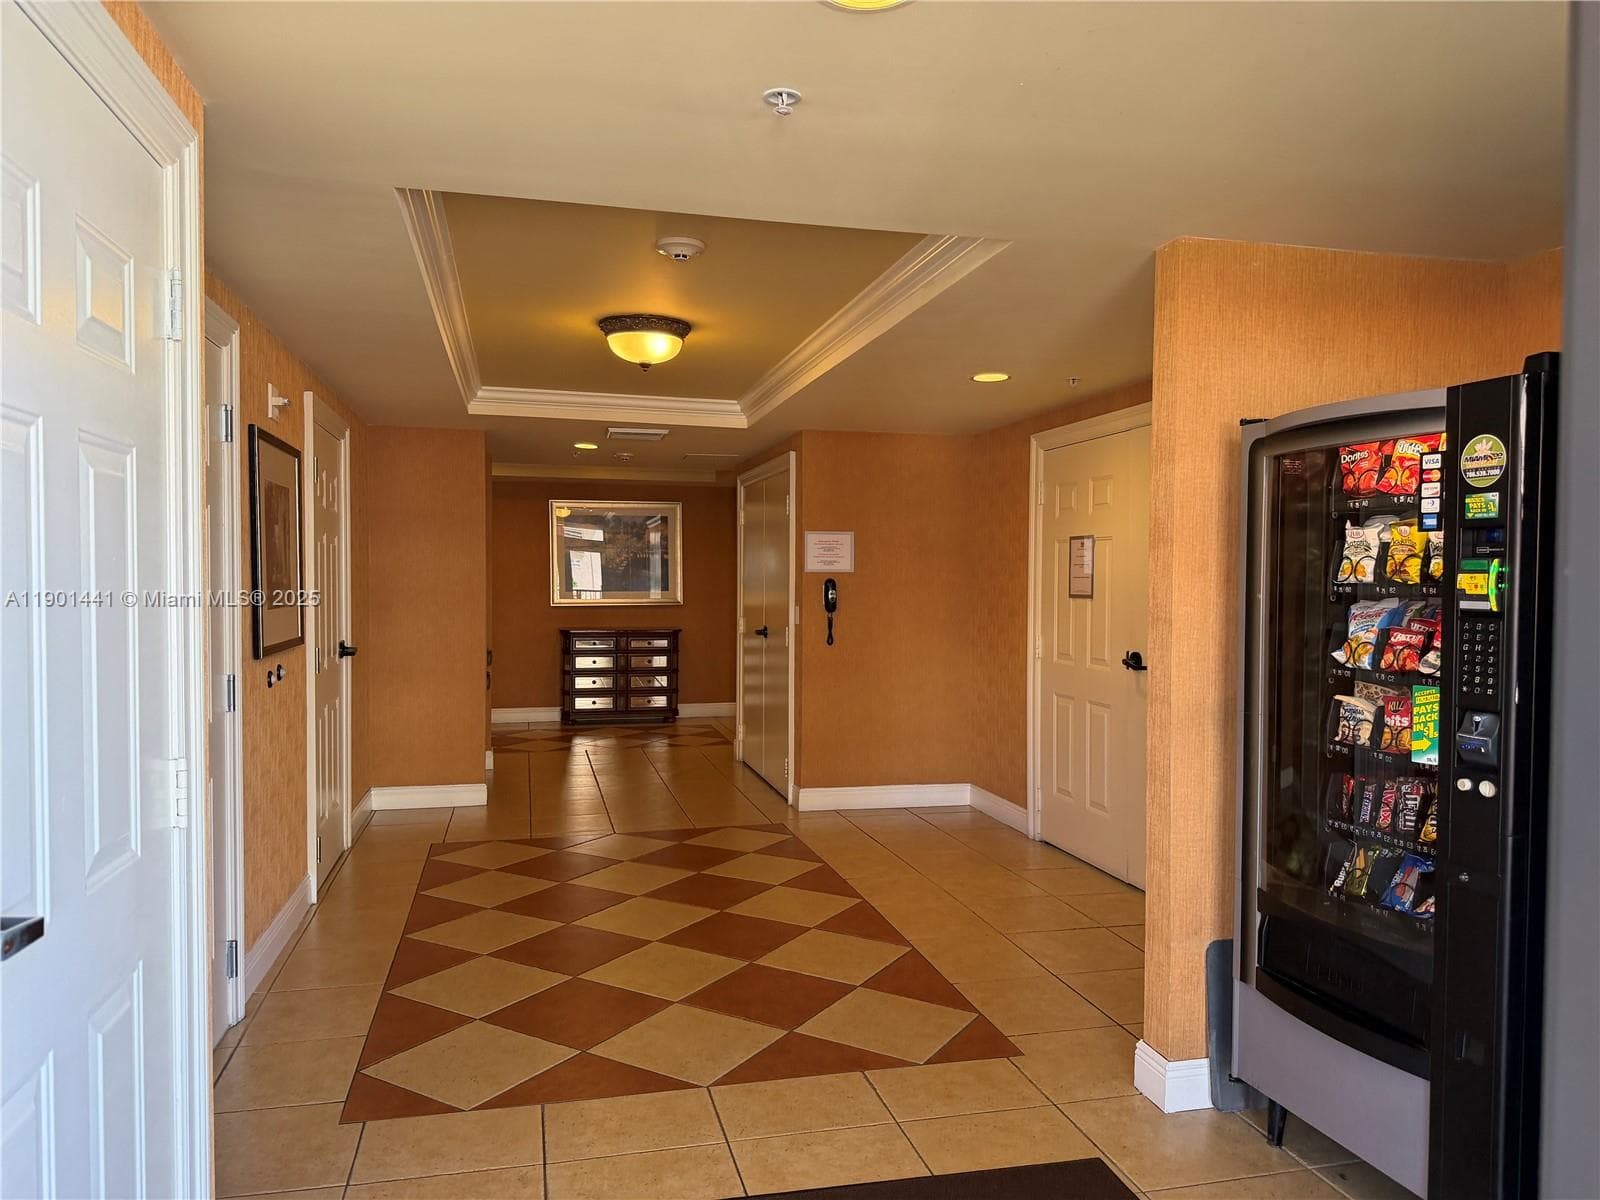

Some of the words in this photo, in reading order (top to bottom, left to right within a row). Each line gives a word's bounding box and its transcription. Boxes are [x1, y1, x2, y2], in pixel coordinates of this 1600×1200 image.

[1341, 450, 1369, 463] Doritos
[1413, 704, 1439, 714] PAYS
[1413, 713, 1438, 723] BACK
